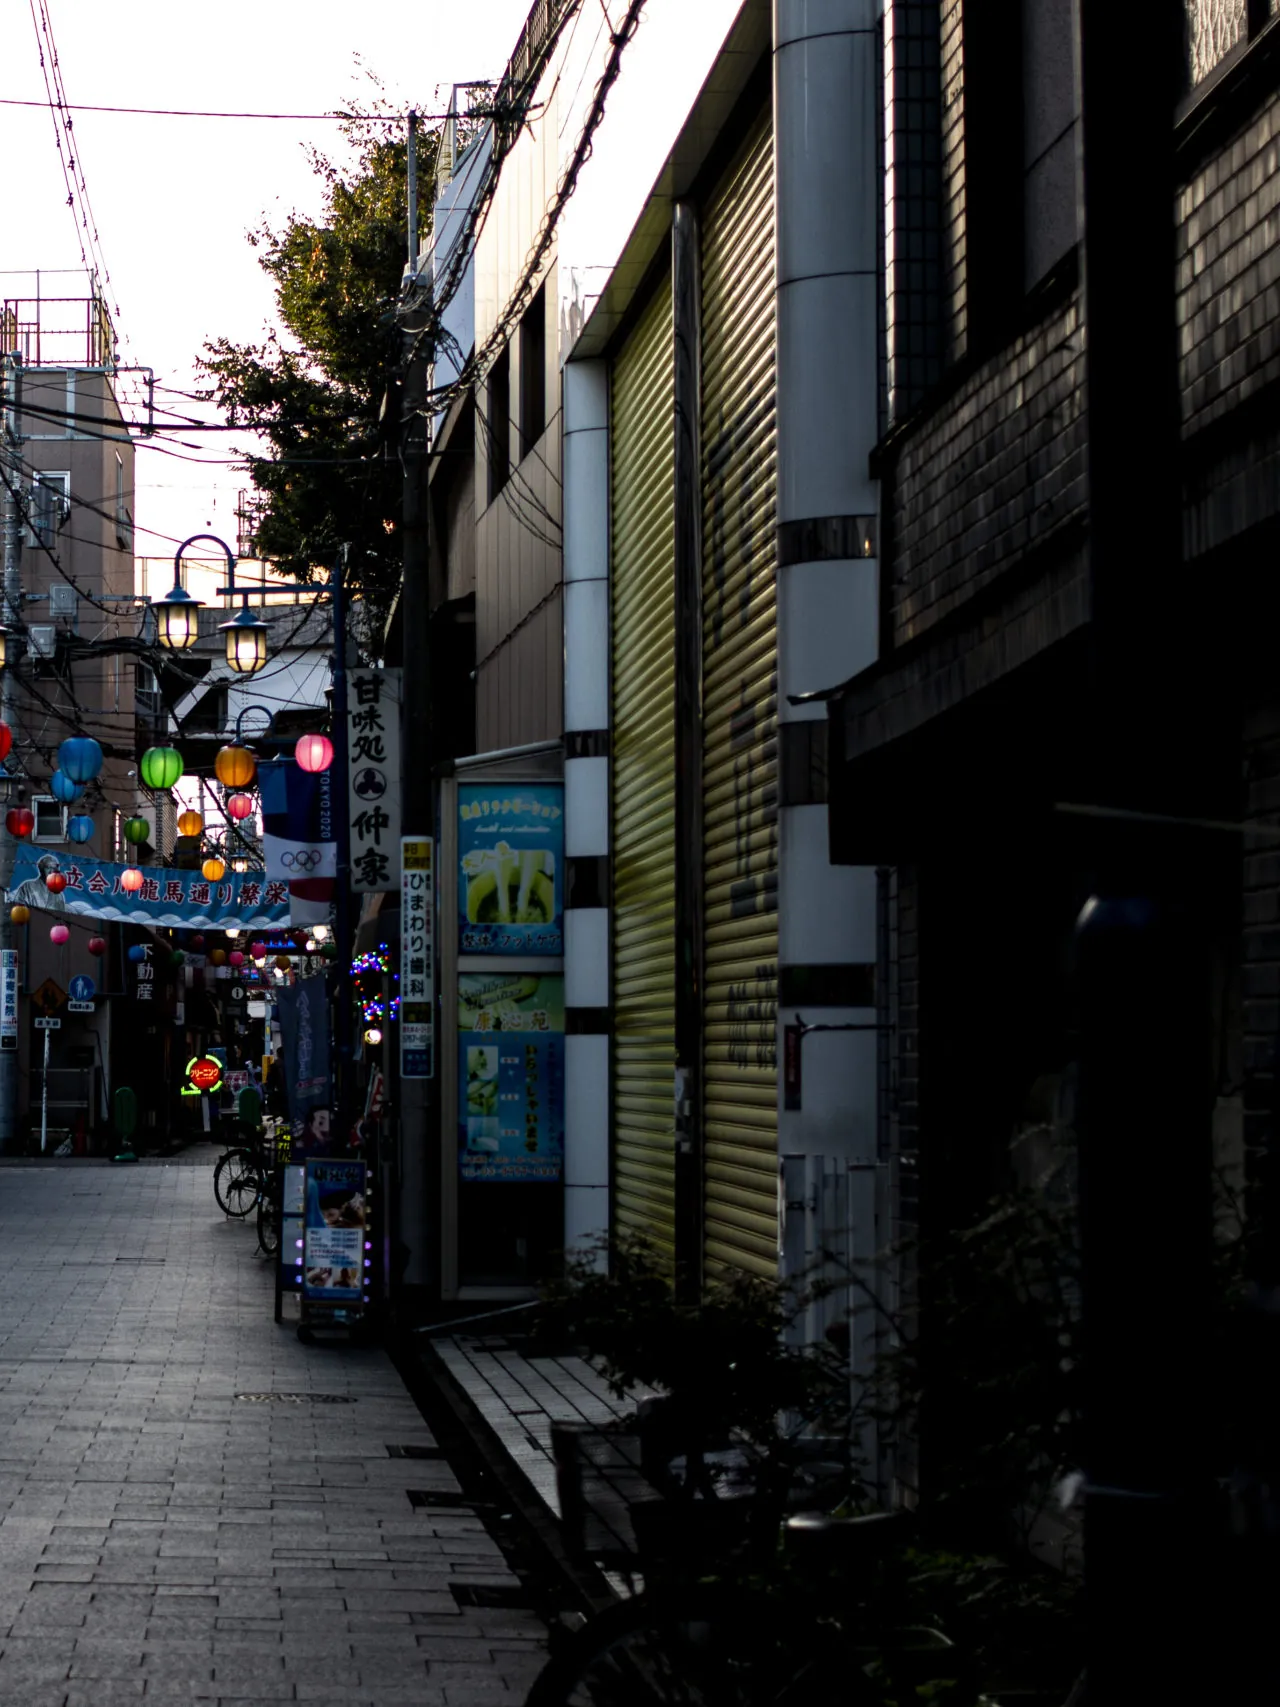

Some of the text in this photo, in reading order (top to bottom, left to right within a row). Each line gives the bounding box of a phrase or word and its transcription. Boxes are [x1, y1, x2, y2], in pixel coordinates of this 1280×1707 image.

[352, 674, 387, 763] 甘味処
[319, 769, 331, 839] TOKYO 2020
[352, 806, 390, 886] 仲家
[409, 873, 424, 997] ひまわり歯科
[190, 1068, 219, 1078] クリーニング
